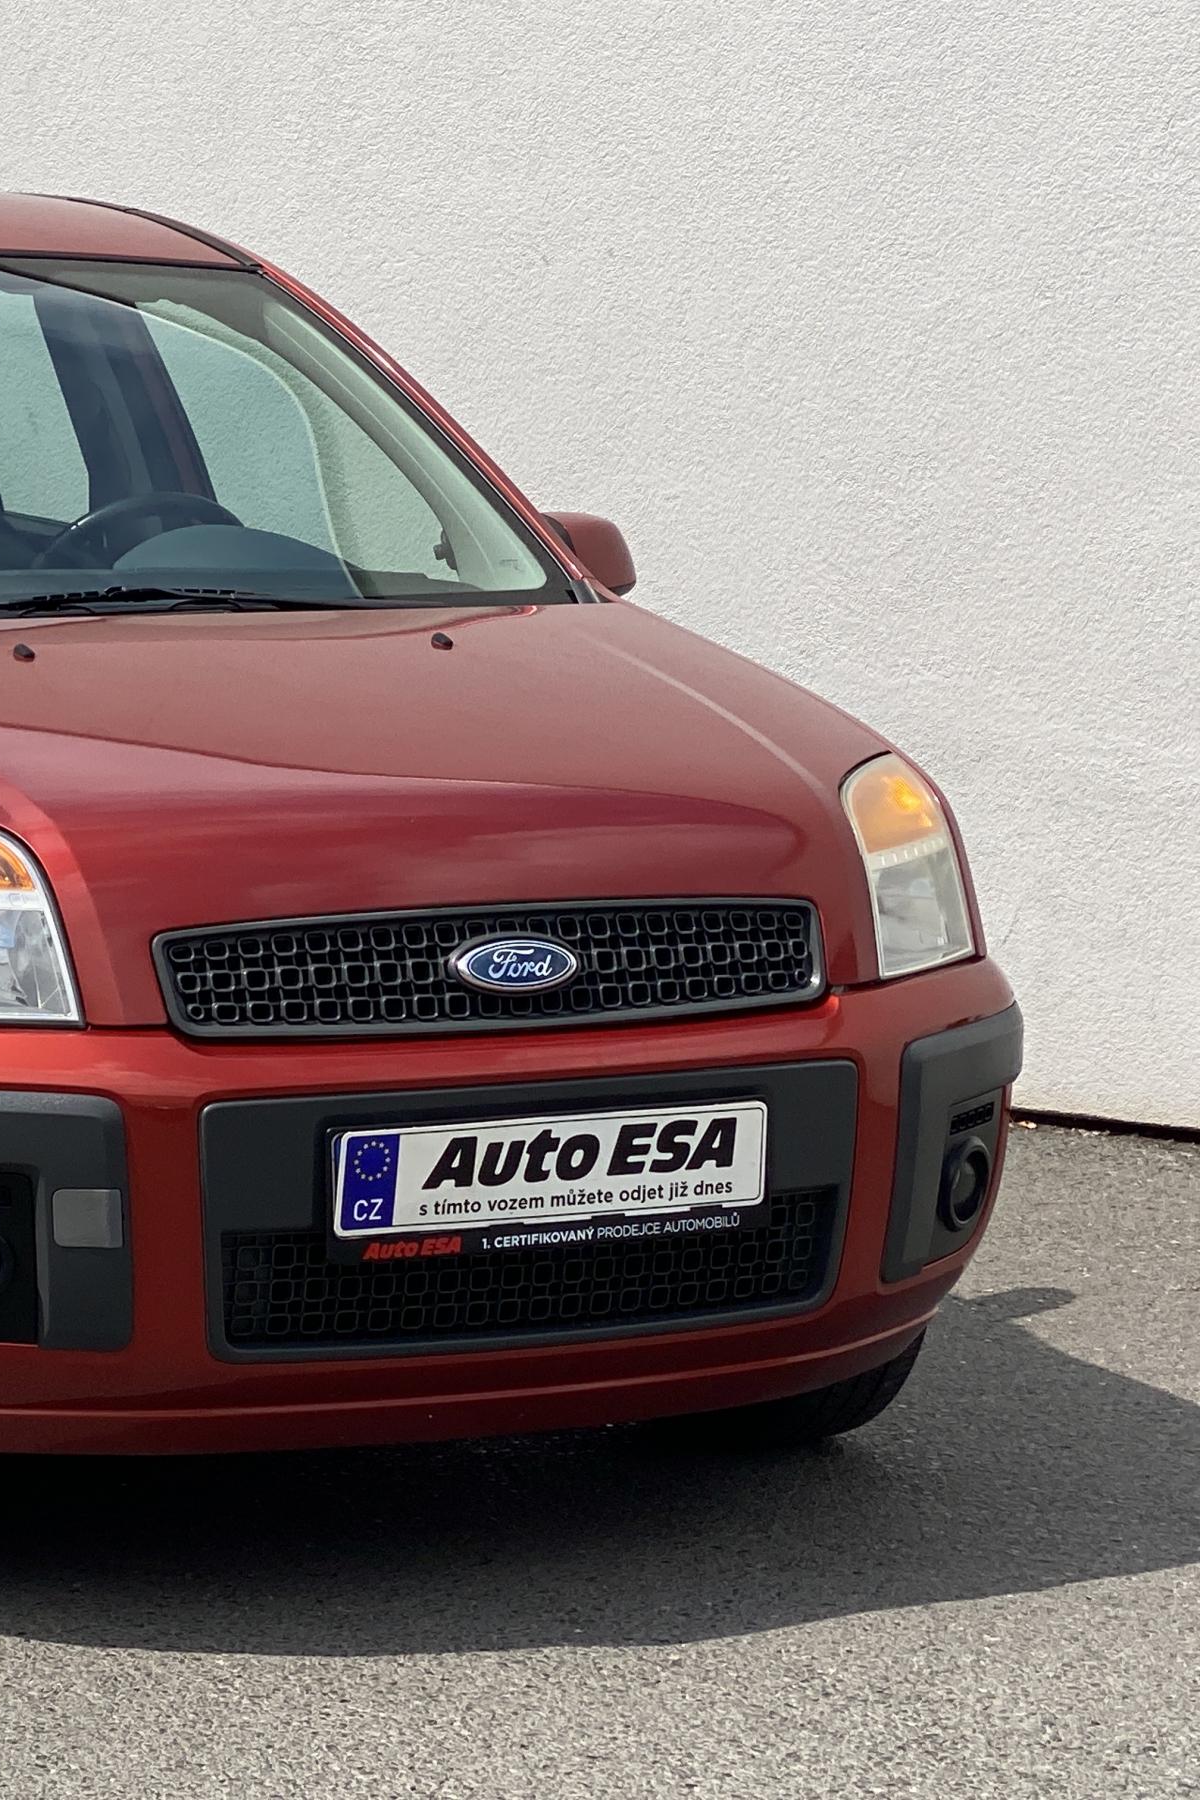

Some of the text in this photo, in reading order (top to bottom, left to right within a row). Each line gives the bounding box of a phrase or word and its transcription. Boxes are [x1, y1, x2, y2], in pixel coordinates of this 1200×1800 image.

[488, 949, 553, 978] Ford
[421, 1117, 737, 1190] Auto ESA
[354, 1198, 382, 1221] CZ
[419, 1180, 733, 1216] s tímto vozem můžete odjet již dnes
[482, 1212, 740, 1249] 1. CERTIFIKOVANÝ PRODEJCE AUTOMOBILŮ
[363, 1237, 461, 1259] Auto ESA
